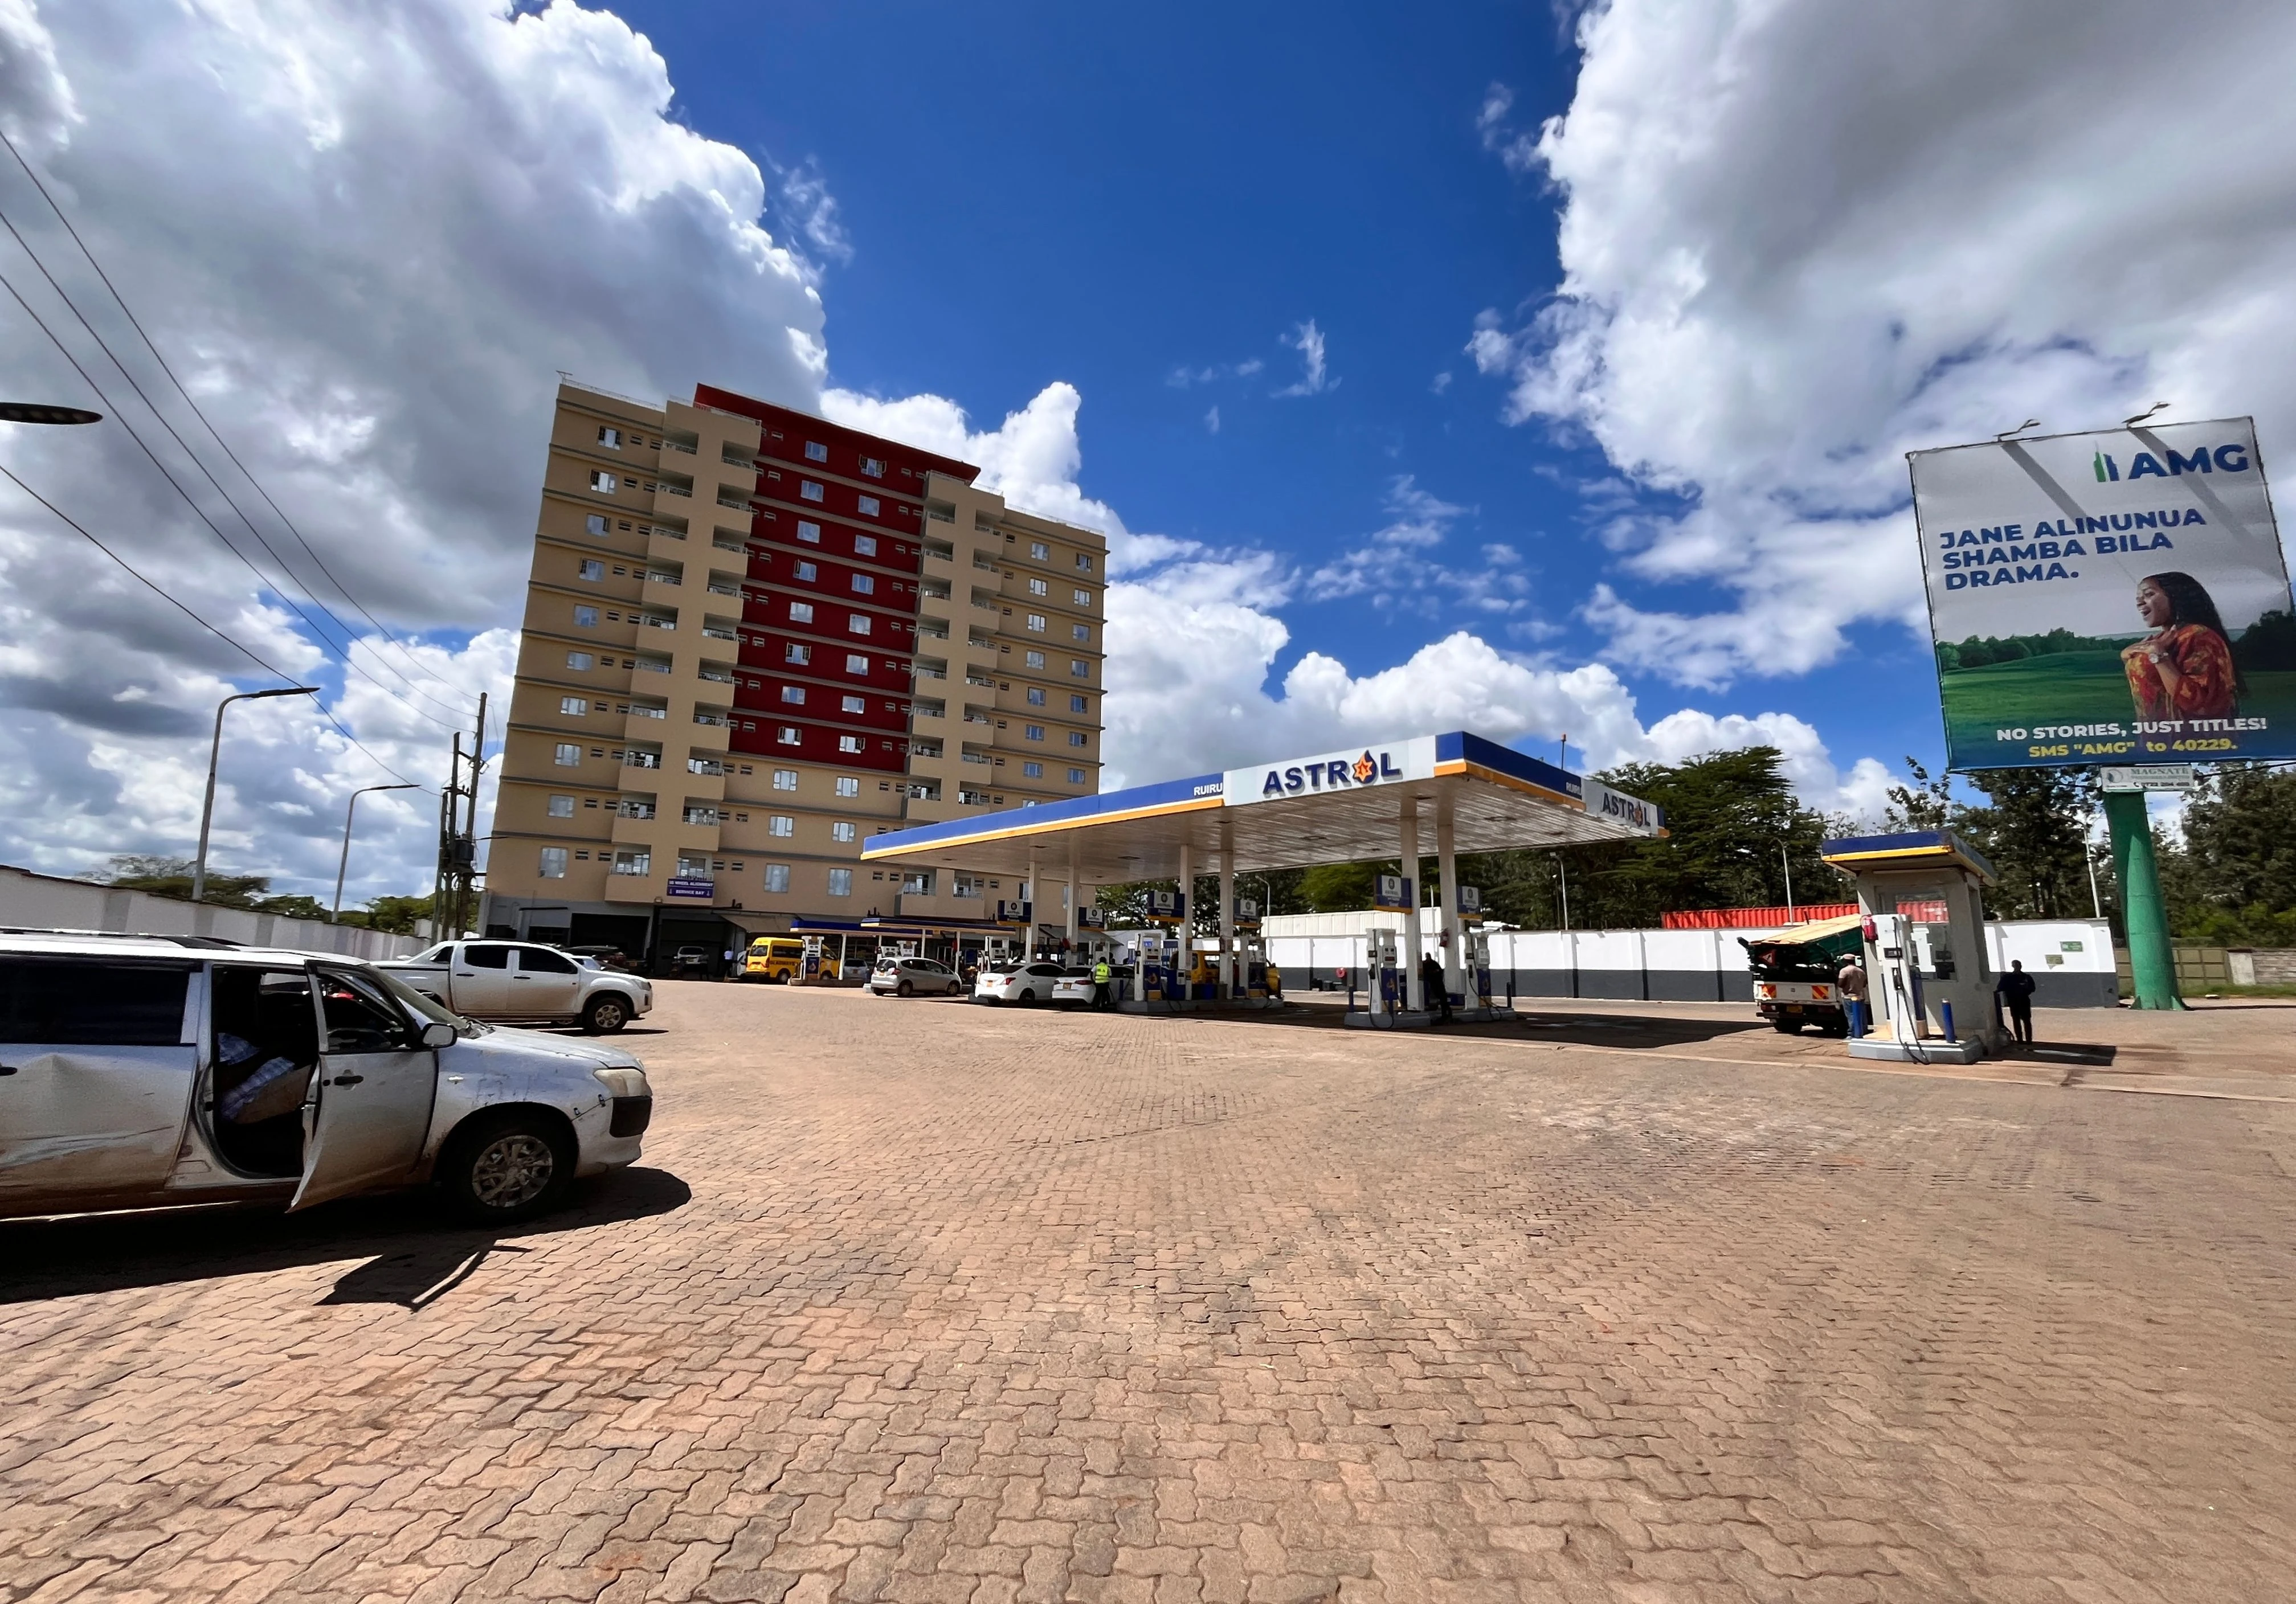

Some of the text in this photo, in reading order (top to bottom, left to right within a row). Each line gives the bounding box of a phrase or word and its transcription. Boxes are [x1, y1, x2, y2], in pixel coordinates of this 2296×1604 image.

[2128, 444, 2249, 480] AMG
[1940, 508, 2207, 549] JANE ALINUNUA
[1942, 532, 2173, 569] SHAMBA BILA
[1946, 562, 2079, 590] DRAMA.
[1997, 718, 2267, 740] NO STORIES, JUST TITLES!
[2029, 738, 2238, 758] SMS "AMG" to 40229.
[1194, 750, 1403, 799] RUIRU ASTROL
